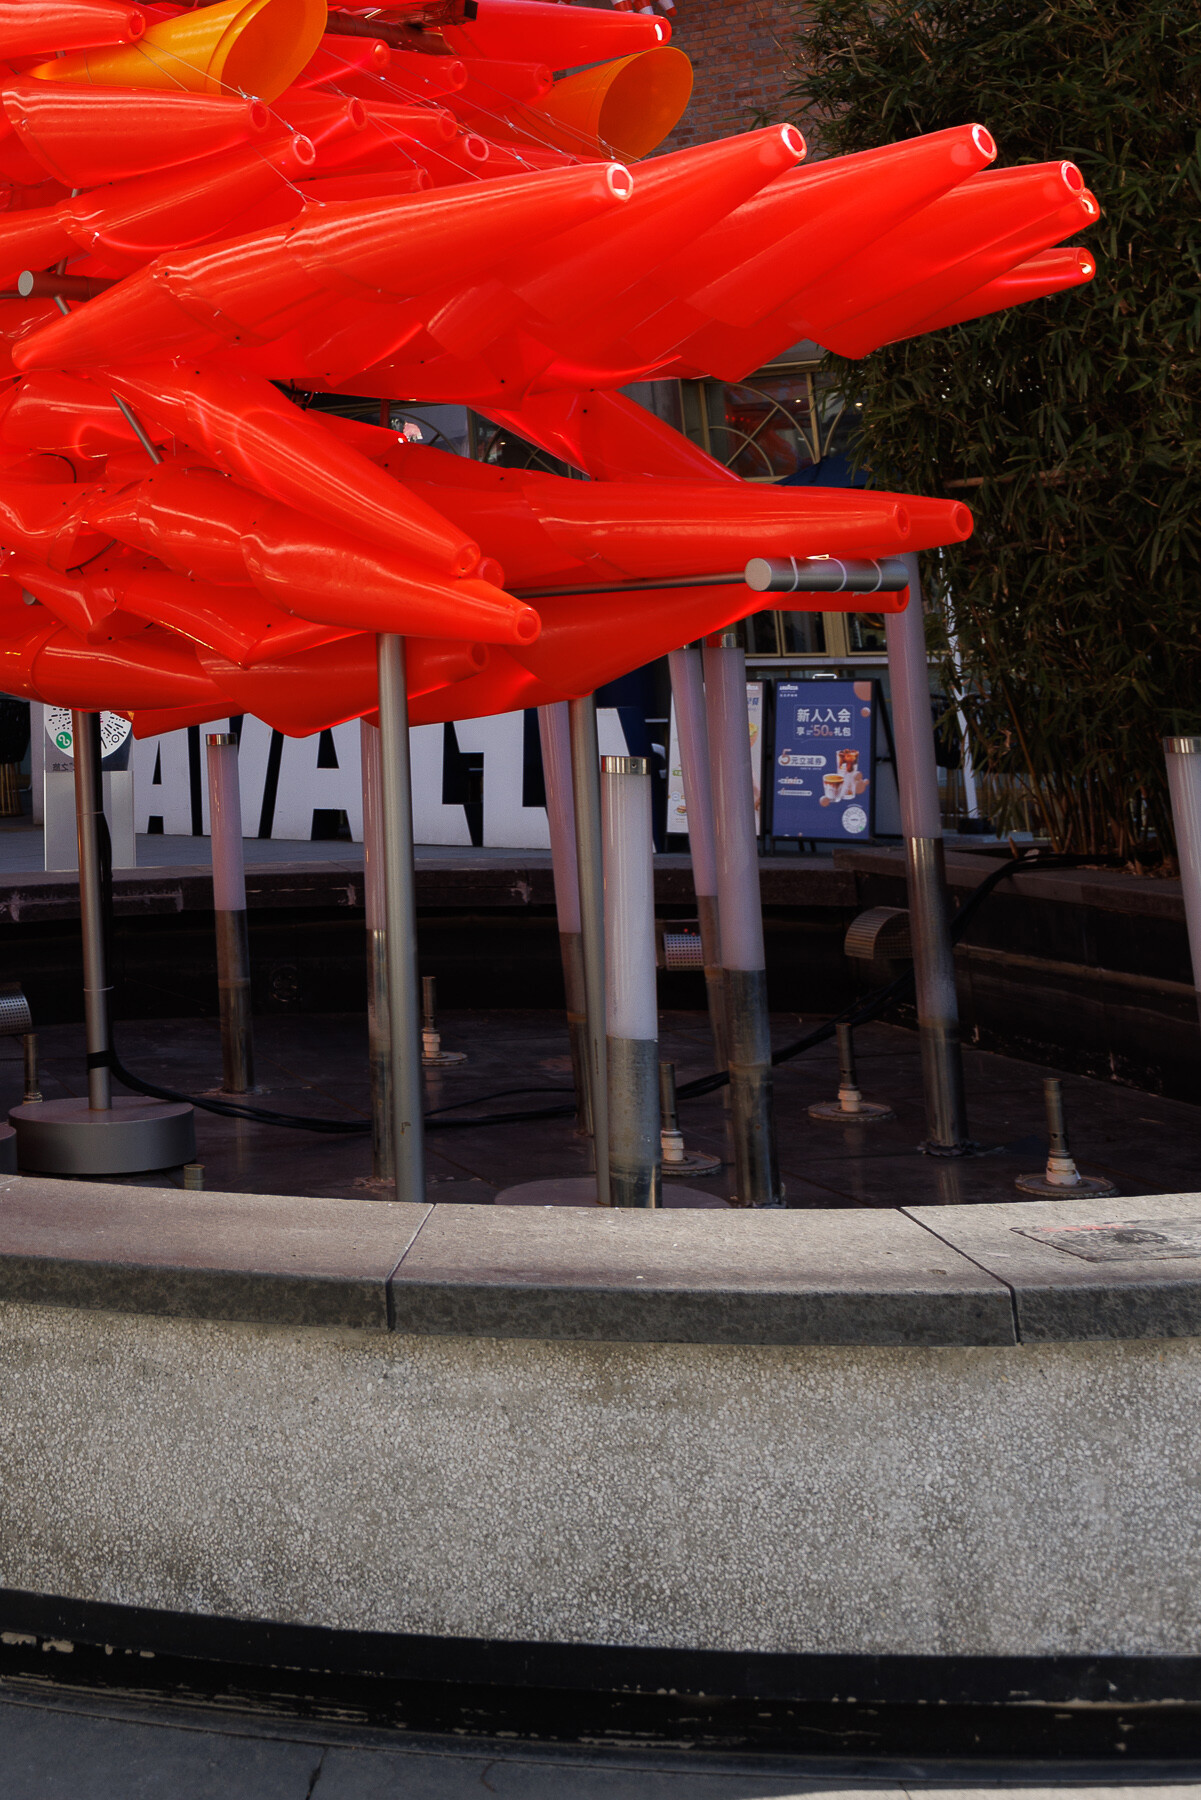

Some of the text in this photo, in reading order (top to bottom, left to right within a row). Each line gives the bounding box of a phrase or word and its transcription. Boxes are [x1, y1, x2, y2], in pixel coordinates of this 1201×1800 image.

[797, 708, 851, 723] 新人入会
[32, 707, 658, 855] AVAZZ
